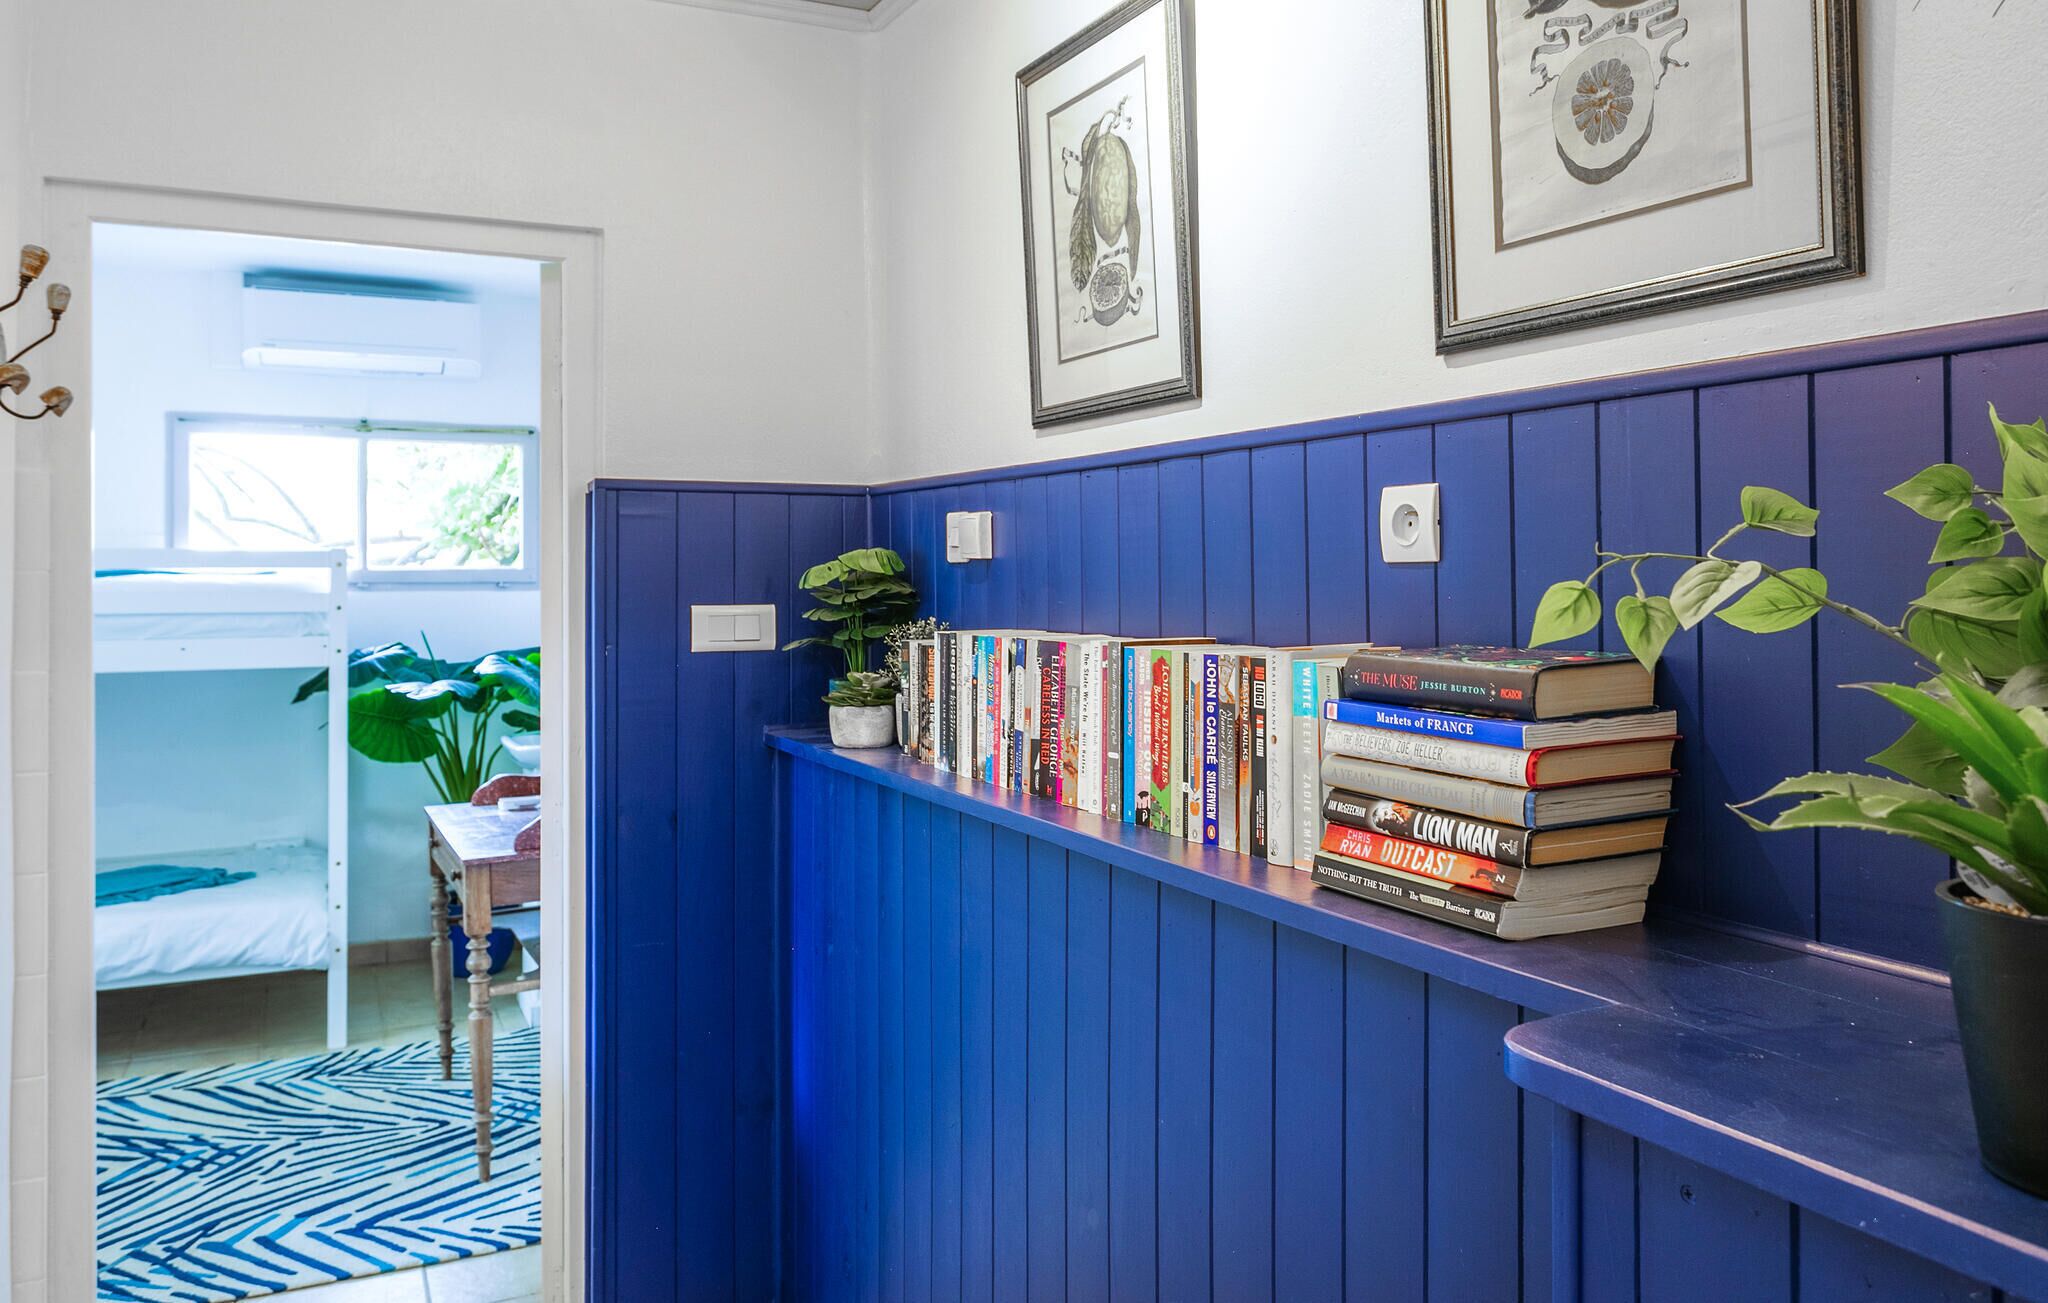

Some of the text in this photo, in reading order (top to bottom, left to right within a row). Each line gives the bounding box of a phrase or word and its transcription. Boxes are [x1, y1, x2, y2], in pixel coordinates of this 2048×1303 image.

[1255, 666, 1264, 707] NO LOGO
[1303, 667, 1311, 709] WHITE
[1361, 672, 1418, 691] THE MUSE
[1420, 681, 1486, 696] JESSIE BURTON
[1500, 688, 1523, 700] PICADOR
[1040, 667, 1051, 765] CARELESS IN RED
[1050, 655, 1059, 778] ELIZABETH GEORGE
[1162, 705, 1168, 715] de
[1376, 712, 1474, 735] Markets of FRANCE
[1206, 659, 1218, 820] JOHN le CARRÉ SILVERVIEW
[1344, 734, 1352, 744] THE
[1152, 742, 1160, 766] Wings
[1414, 743, 1443, 761] HELLER
[1331, 766, 1338, 774] A
[1344, 768, 1367, 781] YEAR
[1368, 773, 1382, 785] AT
[1386, 776, 1407, 790] THE
[1328, 800, 1337, 810] IAN
[1347, 830, 1370, 844] CHRIS
[1413, 812, 1451, 846] LION
[1456, 822, 1499, 858] MAN
[1340, 840, 1372, 858] RYAN
[1381, 840, 1457, 877] OUTCAST
[1318, 865, 1402, 896] NOTHING BUT THE TRUTH
[1408, 891, 1419, 901] The
[1445, 901, 1470, 916] Barrister
[1474, 908, 1496, 922] PICADOR
